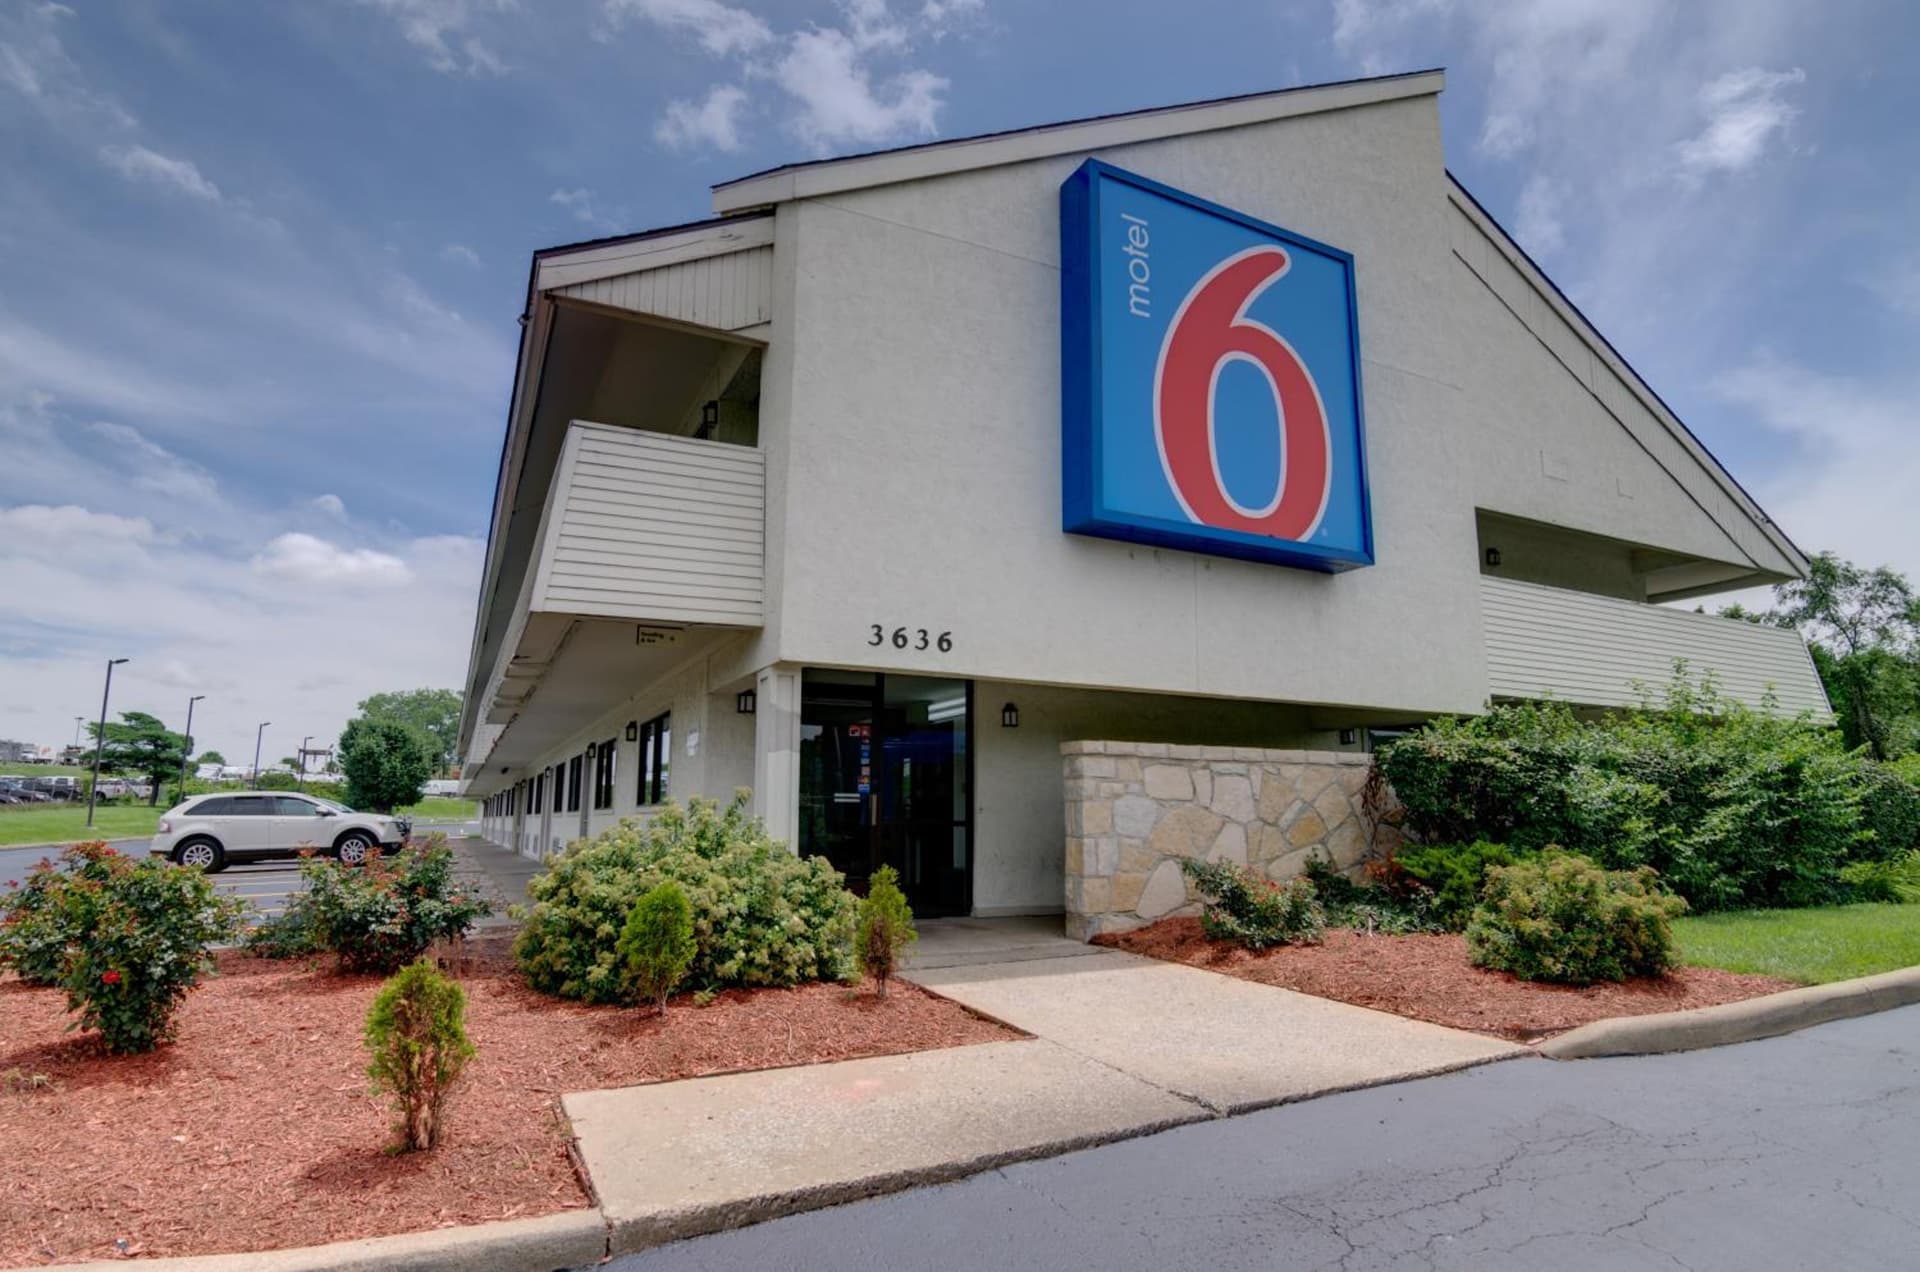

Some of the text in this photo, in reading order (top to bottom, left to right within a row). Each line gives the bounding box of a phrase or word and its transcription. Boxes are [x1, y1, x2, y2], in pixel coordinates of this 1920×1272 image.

[1120, 212, 1150, 318] motel
[1153, 244, 1333, 542] 6
[867, 624, 953, 653] 3636
